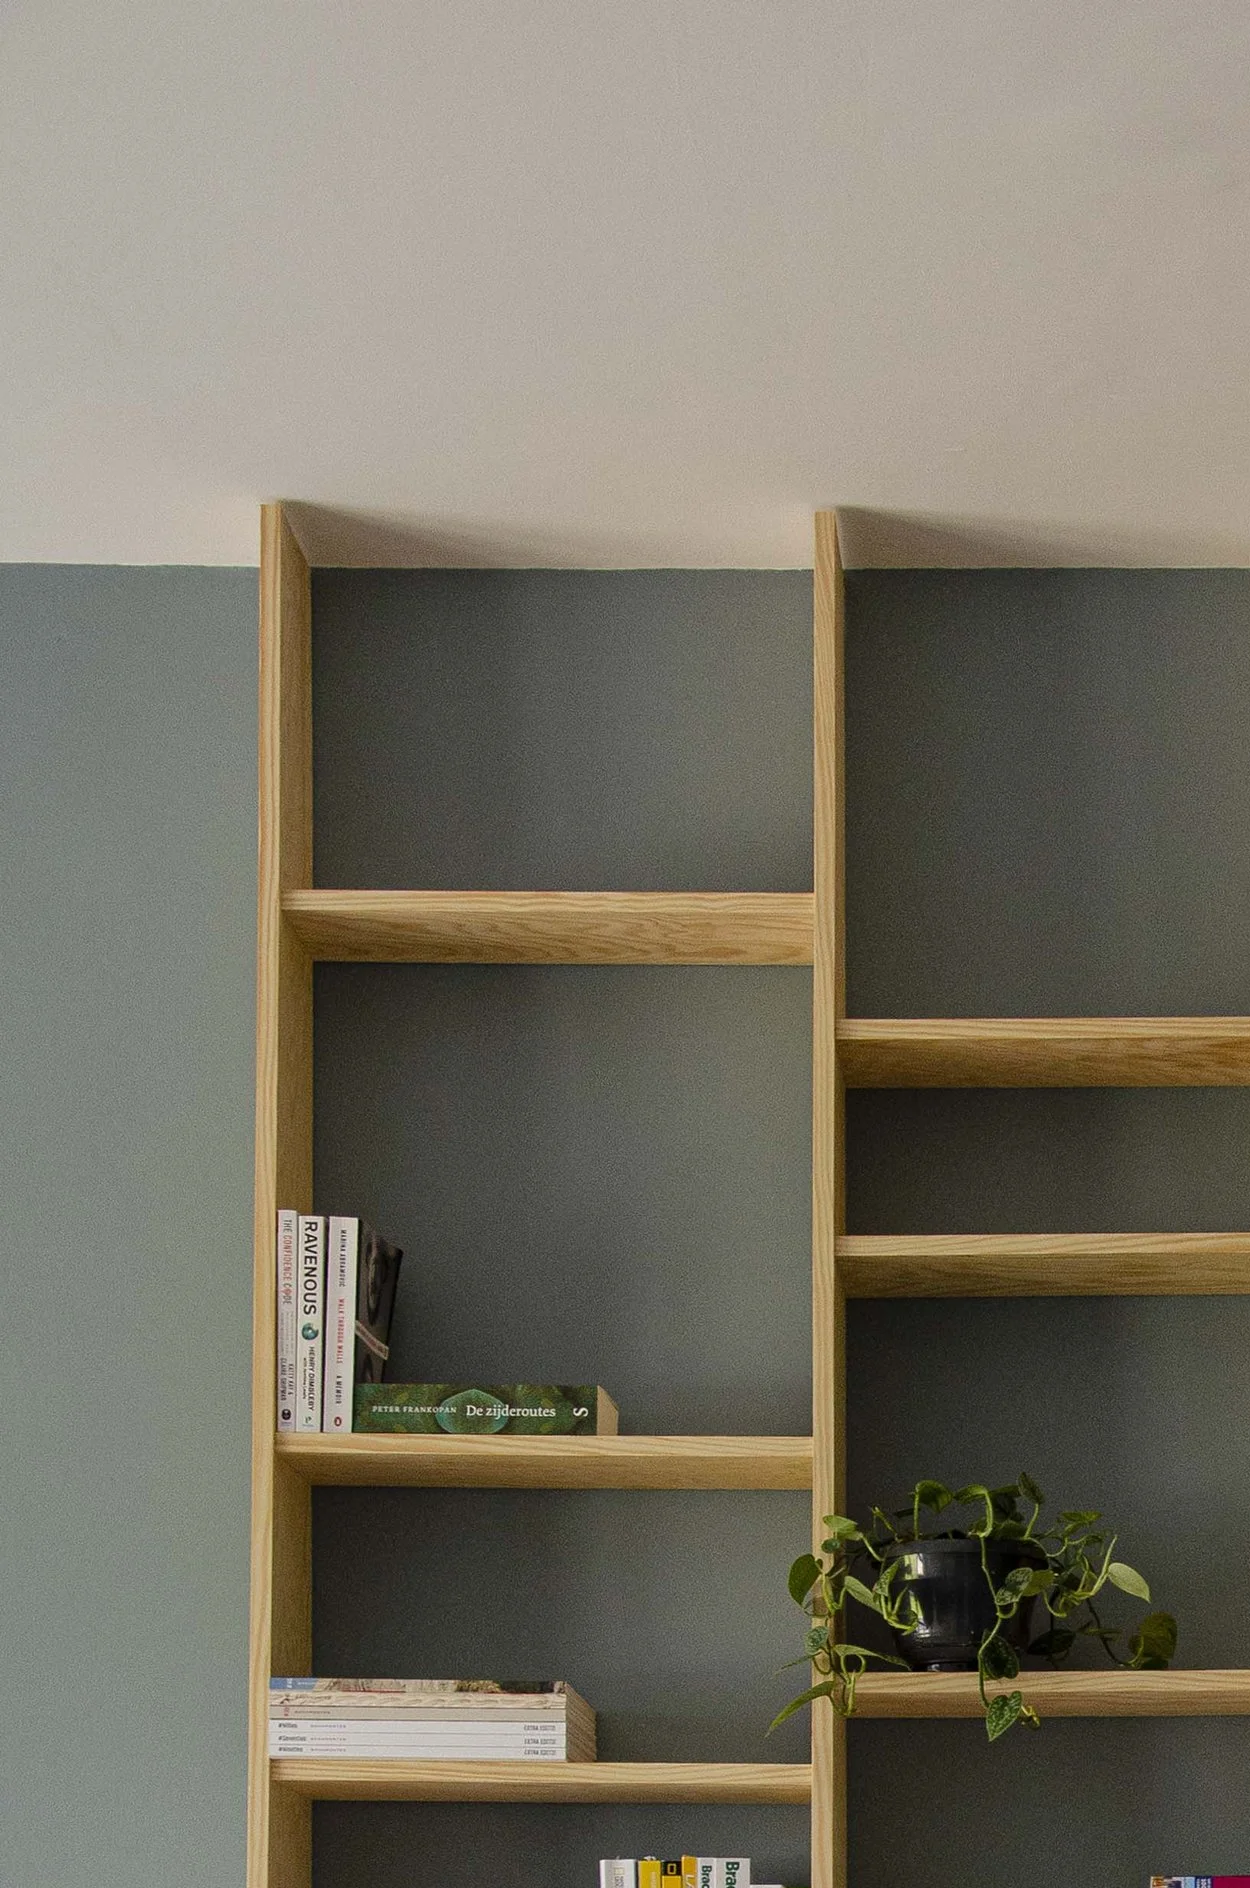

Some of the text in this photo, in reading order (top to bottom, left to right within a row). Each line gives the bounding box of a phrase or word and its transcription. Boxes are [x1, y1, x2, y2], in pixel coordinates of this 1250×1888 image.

[283, 1219, 293, 1233] THE
[283, 1234, 293, 1282] CONFIDENCE
[303, 1221, 319, 1316] RAVENOUS
[336, 1345, 344, 1364] WALLS
[307, 1373, 315, 1412] DIMBLEBY
[372, 1405, 457, 1414] PETER FRANKOPAN
[466, 1404, 556, 1420] De zijderoutes
